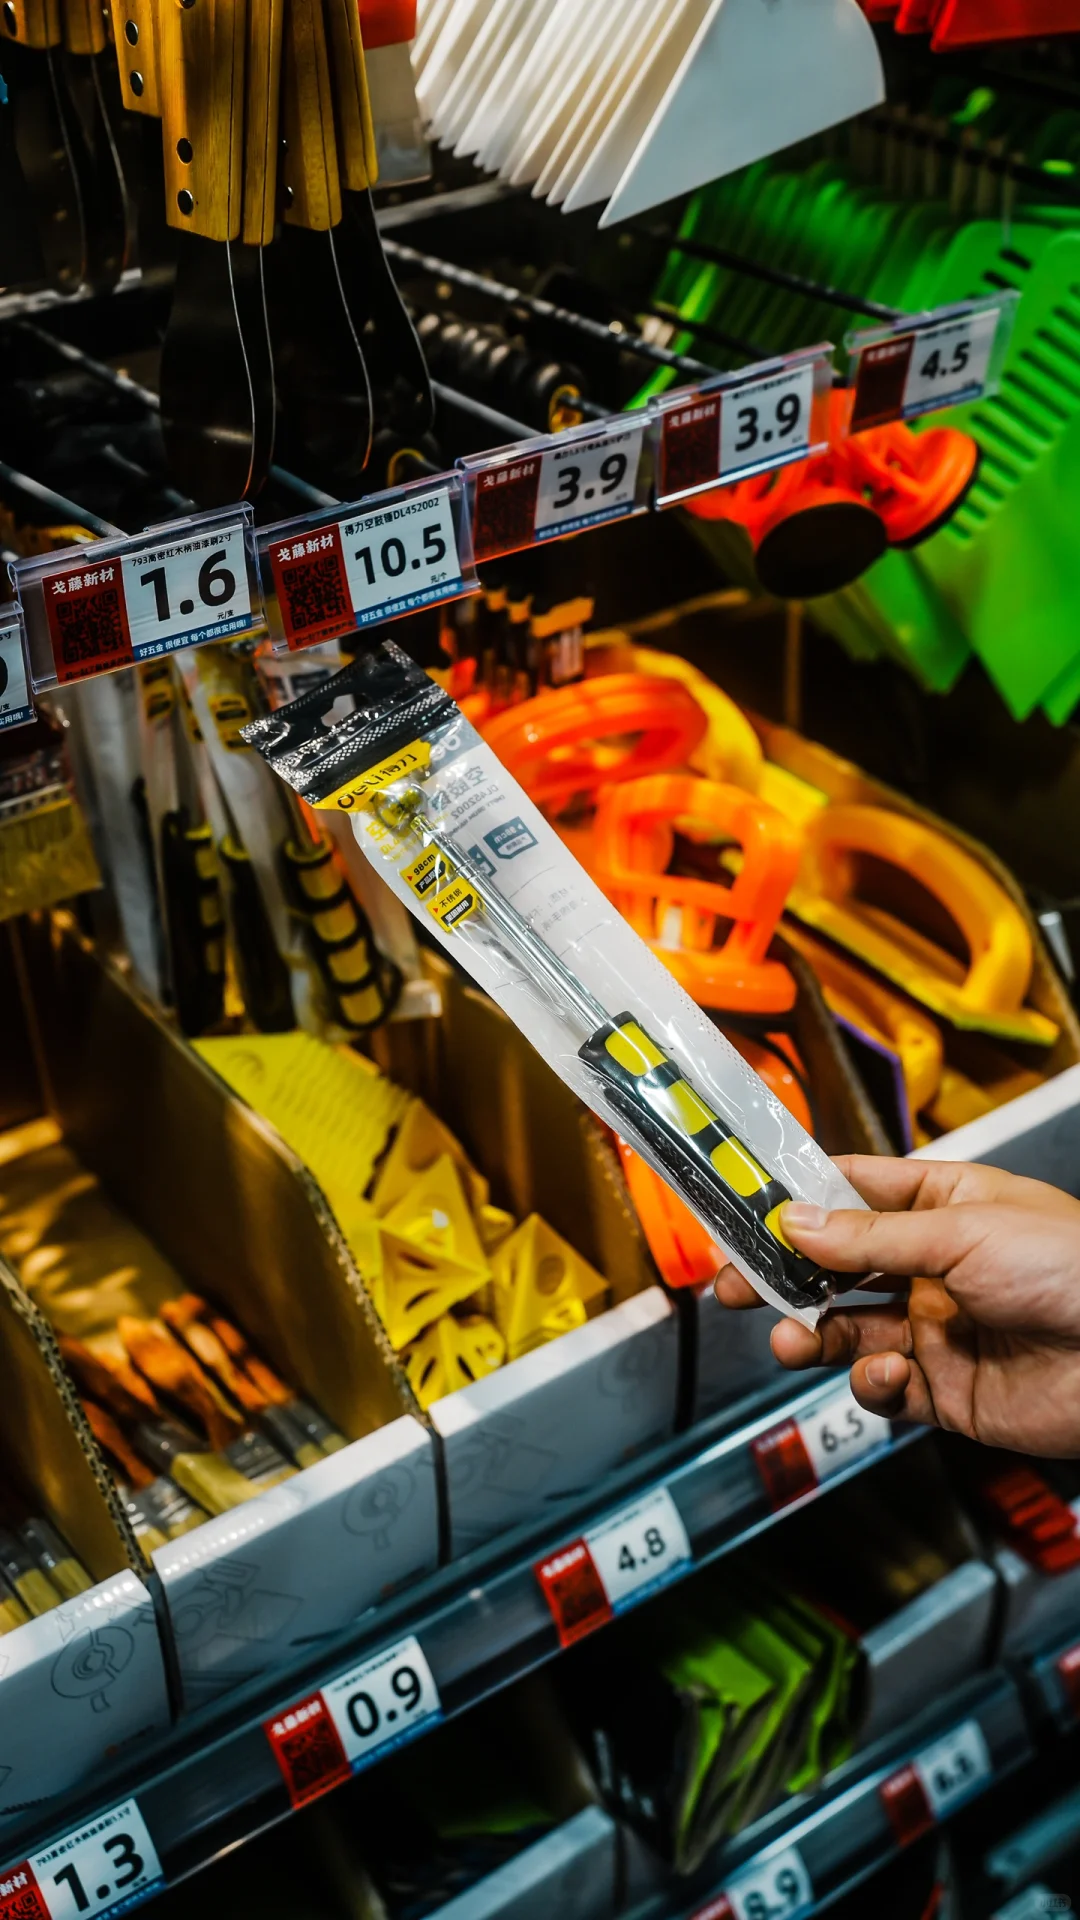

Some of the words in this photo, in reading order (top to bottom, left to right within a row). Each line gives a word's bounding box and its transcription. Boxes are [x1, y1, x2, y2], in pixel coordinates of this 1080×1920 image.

[920, 340, 972, 380] 4.5
[735, 393, 802, 453] 3.9
[553, 452, 628, 509] 3.9
[277, 533, 334, 563] 戈藤新材
[354, 523, 446, 585] 10.5
[51, 566, 115, 596] 戈藤新材
[140, 549, 237, 622] 1.6
[139, 642, 164, 658] 好五金
[165, 635, 190, 651] 很便宜
[413, 853, 436, 876] 98cm
[439, 888, 463, 908] 不锈钢
[821, 1408, 865, 1453] 6.5
[618, 1526, 667, 1572] 4.8
[347, 1665, 422, 1738] 0.9
[53, 1833, 145, 1913] 1.3
